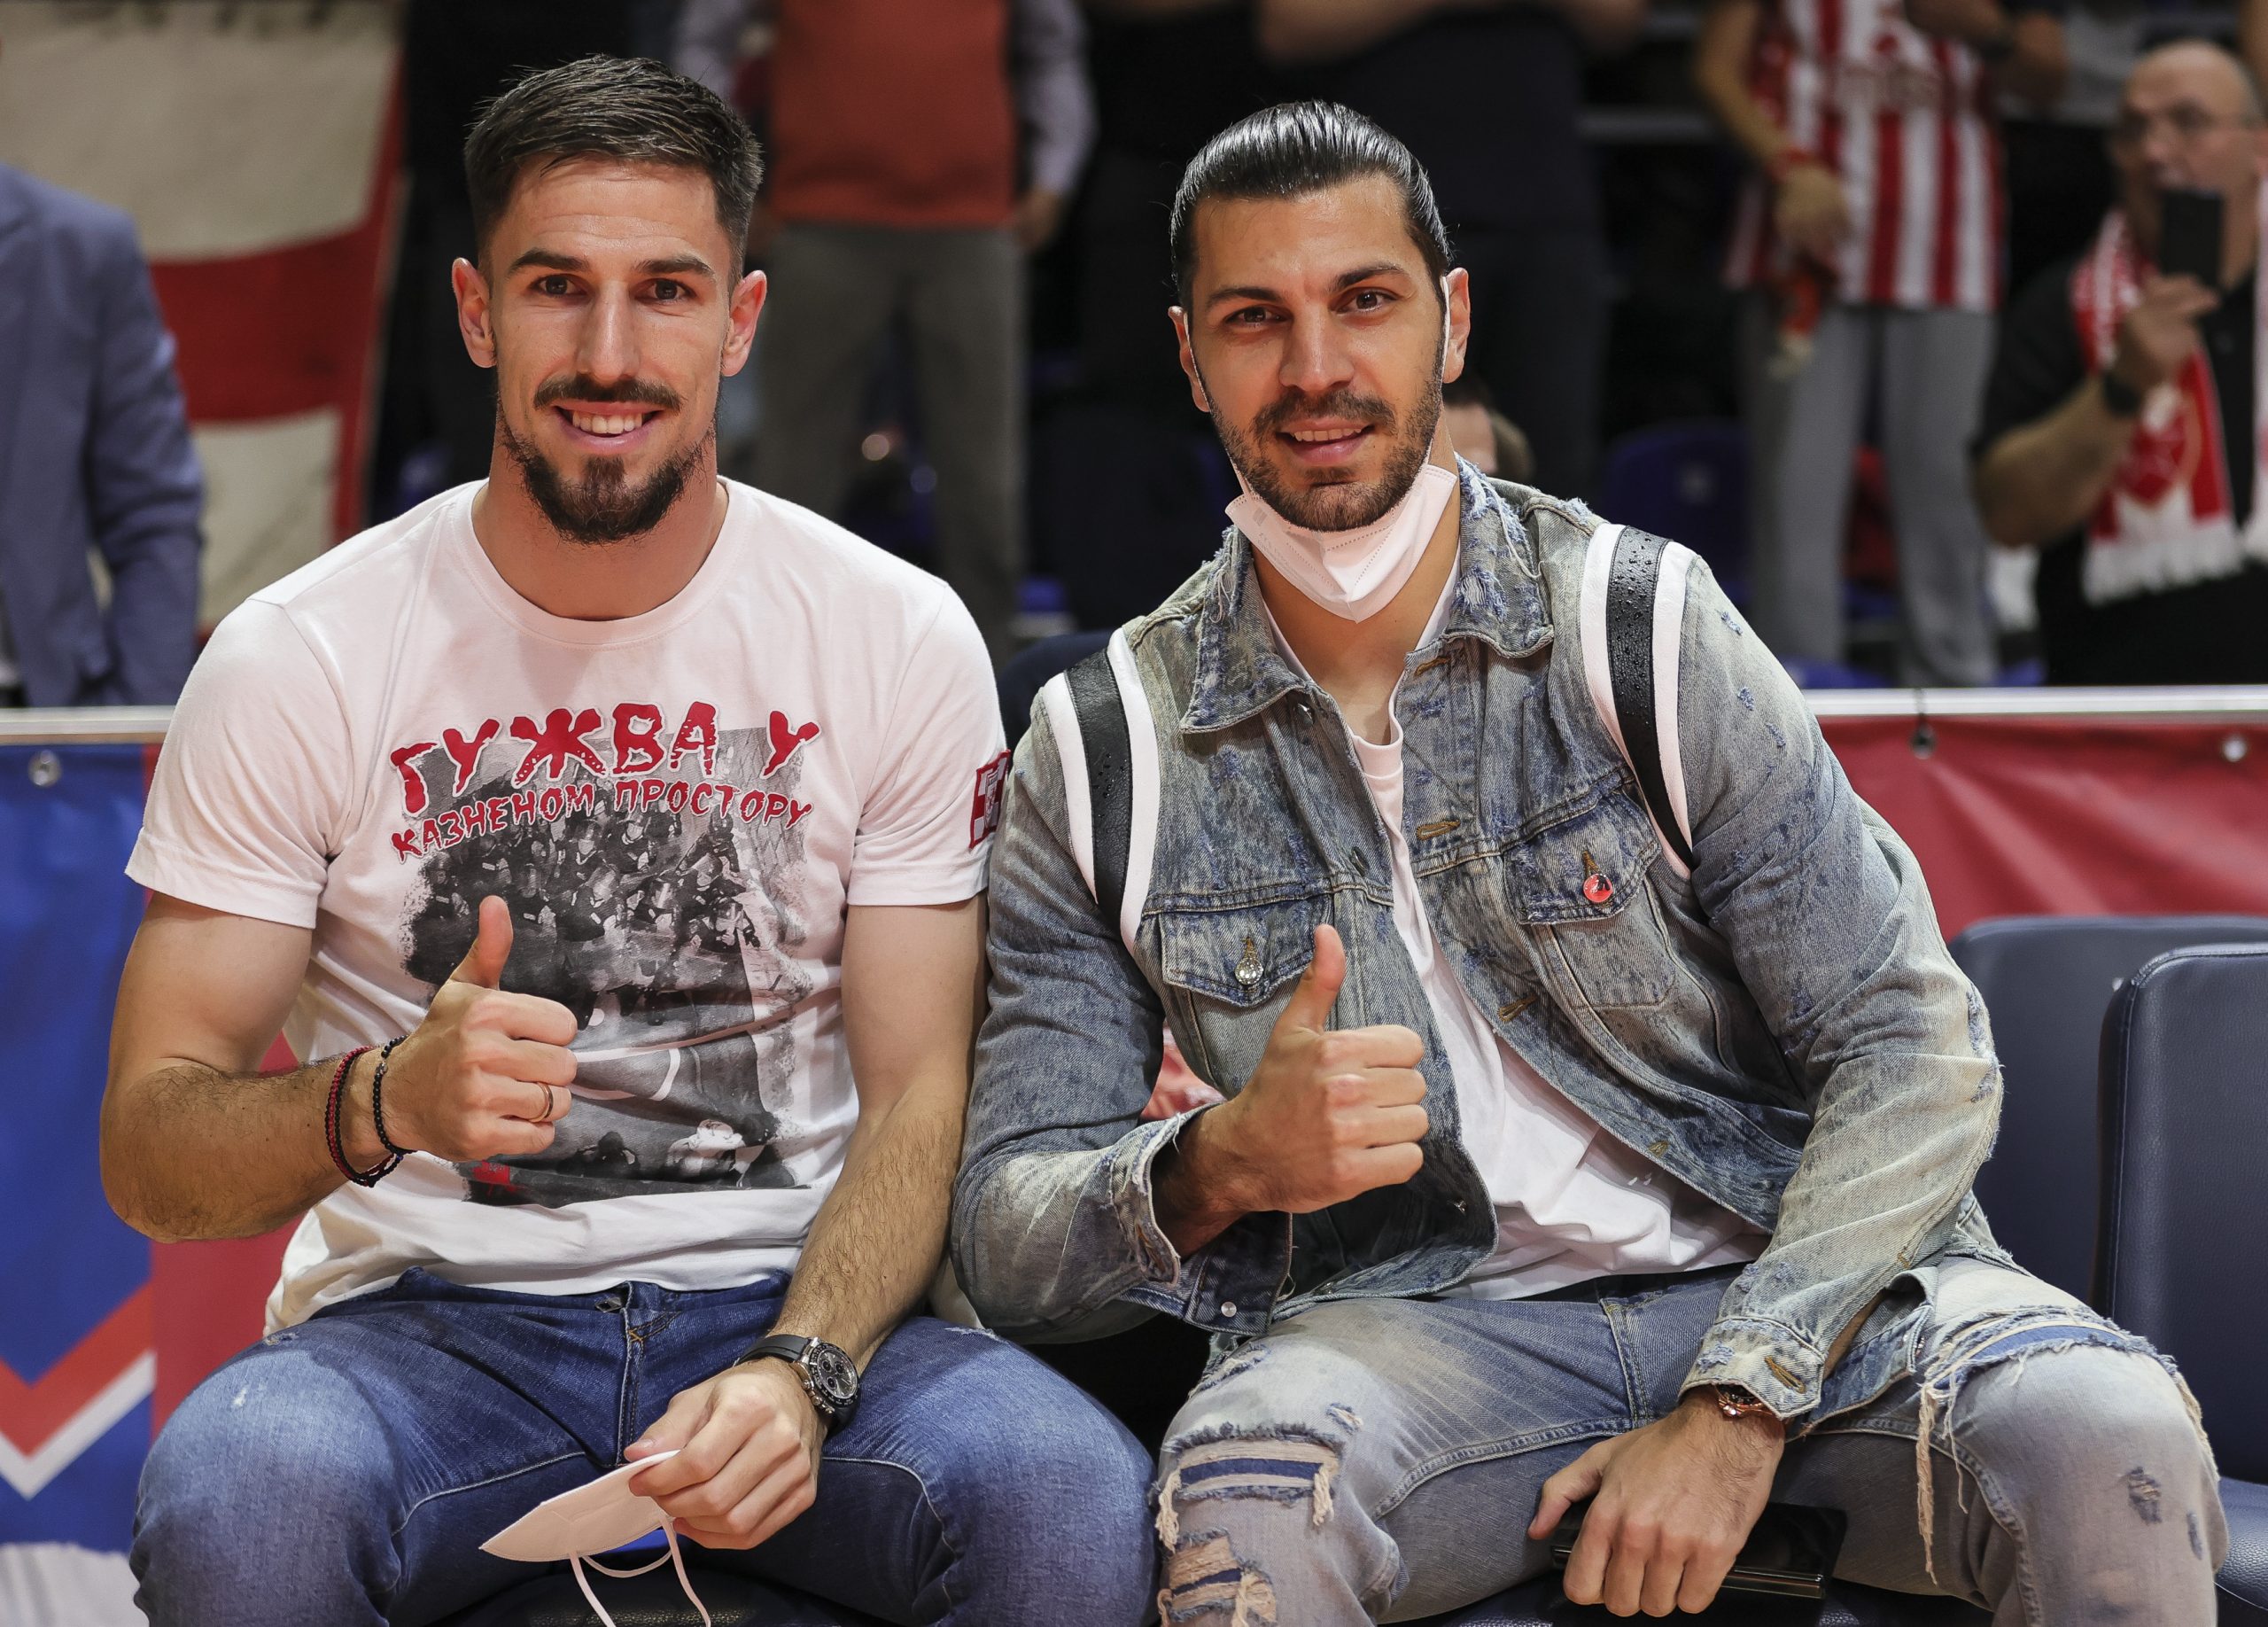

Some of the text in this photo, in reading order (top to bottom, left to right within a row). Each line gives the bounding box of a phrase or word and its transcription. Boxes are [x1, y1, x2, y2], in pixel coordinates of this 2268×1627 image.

[390, 701, 819, 814] ГУЖВА У
[390, 779, 813, 862] КАЗНЕНОМ ПРОСТОРУ
